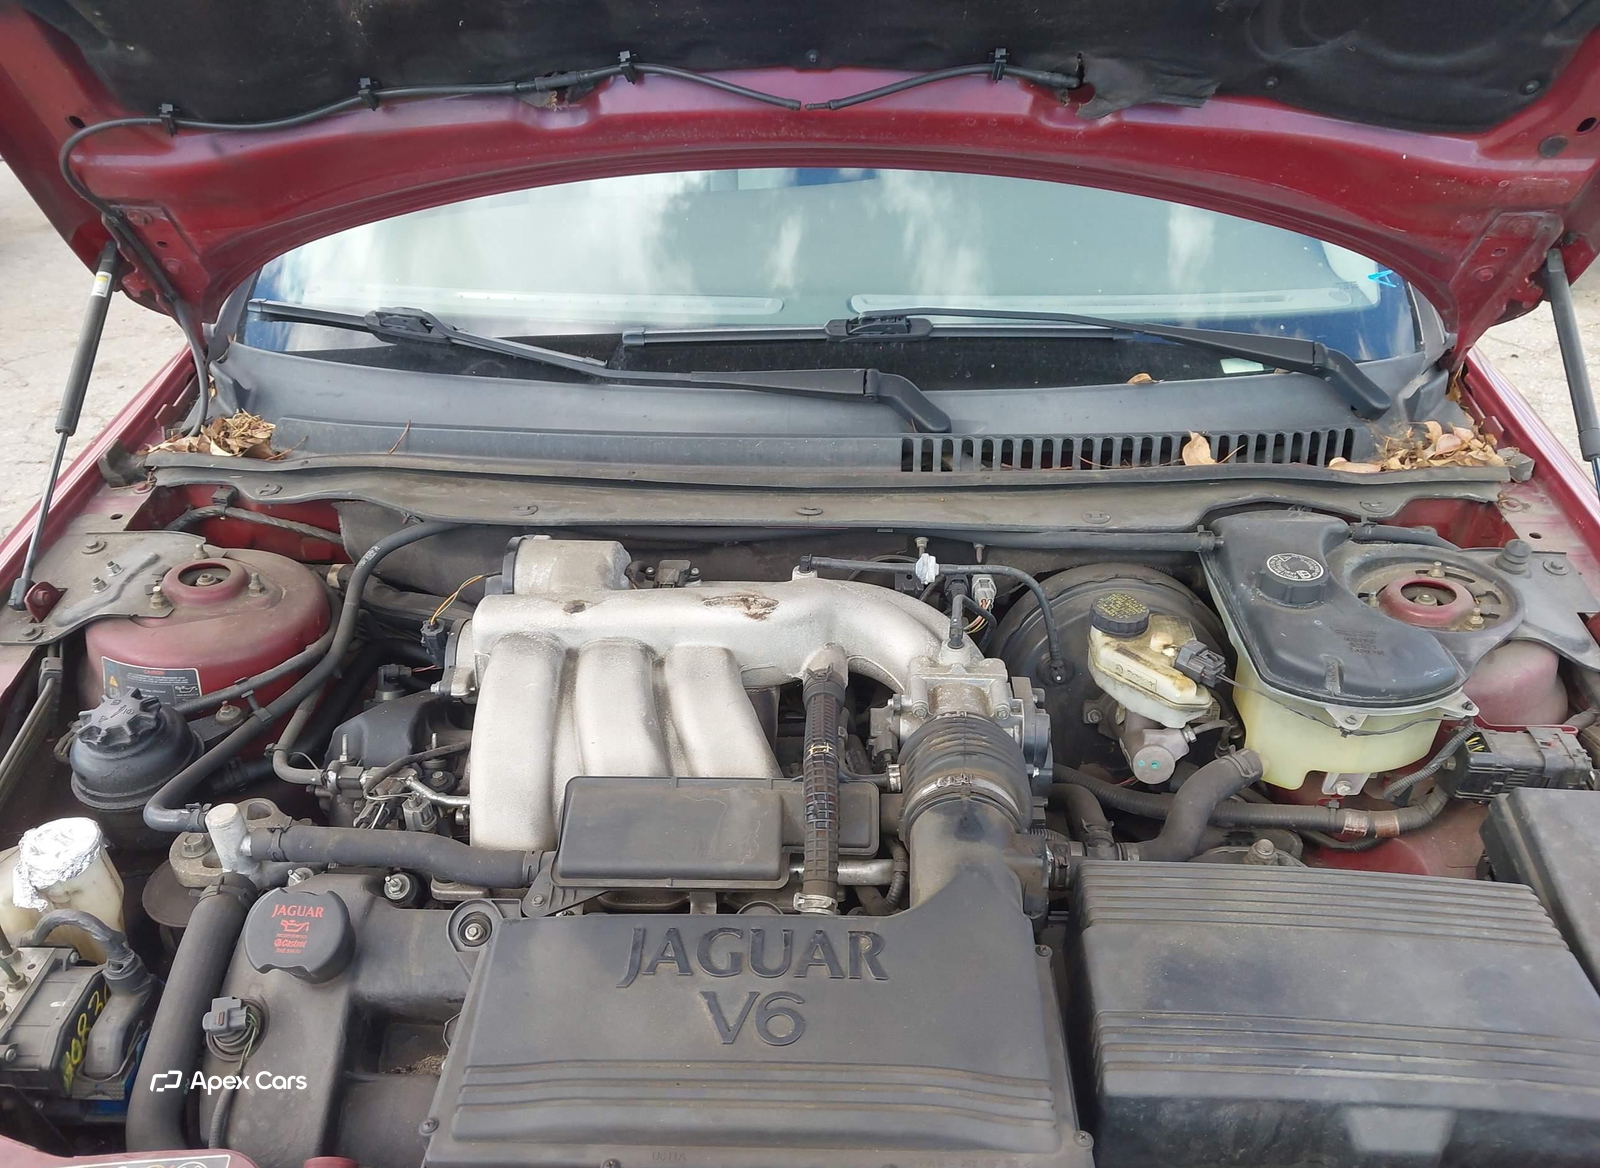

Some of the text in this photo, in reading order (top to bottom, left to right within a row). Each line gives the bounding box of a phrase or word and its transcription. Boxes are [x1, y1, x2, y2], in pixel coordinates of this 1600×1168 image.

[271, 904, 325, 919] JAGUAR
[615, 926, 890, 988] JAGUAR
[699, 990, 807, 1047] V6
